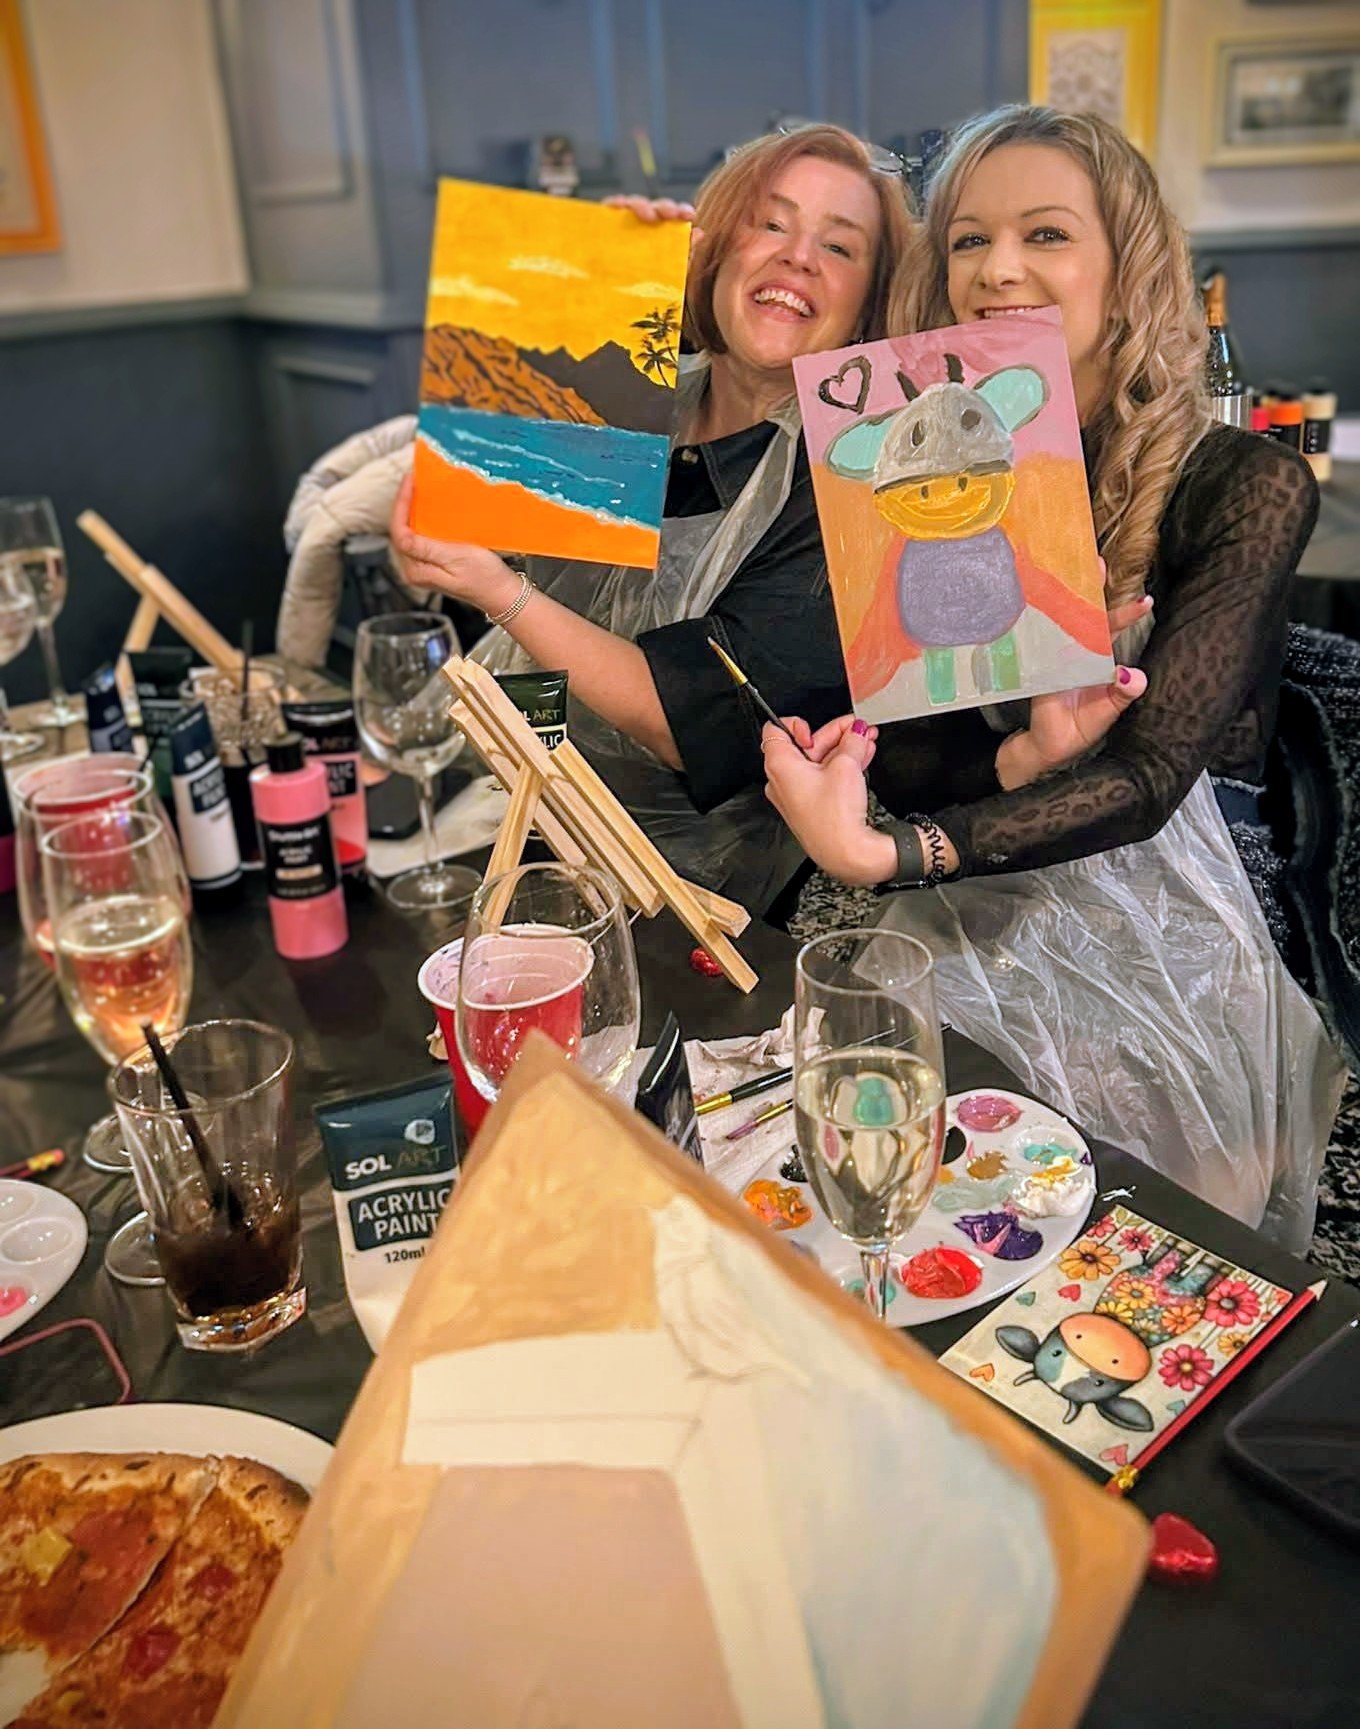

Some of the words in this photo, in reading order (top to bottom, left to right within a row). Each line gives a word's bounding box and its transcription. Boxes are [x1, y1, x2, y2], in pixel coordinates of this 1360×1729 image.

[533, 709, 561, 721] ART
[345, 1154, 392, 1180] SOL
[358, 1188, 451, 1222] ACRYLIC
[374, 1212, 439, 1240] PAINT
[385, 1246, 425, 1263] 120ml
